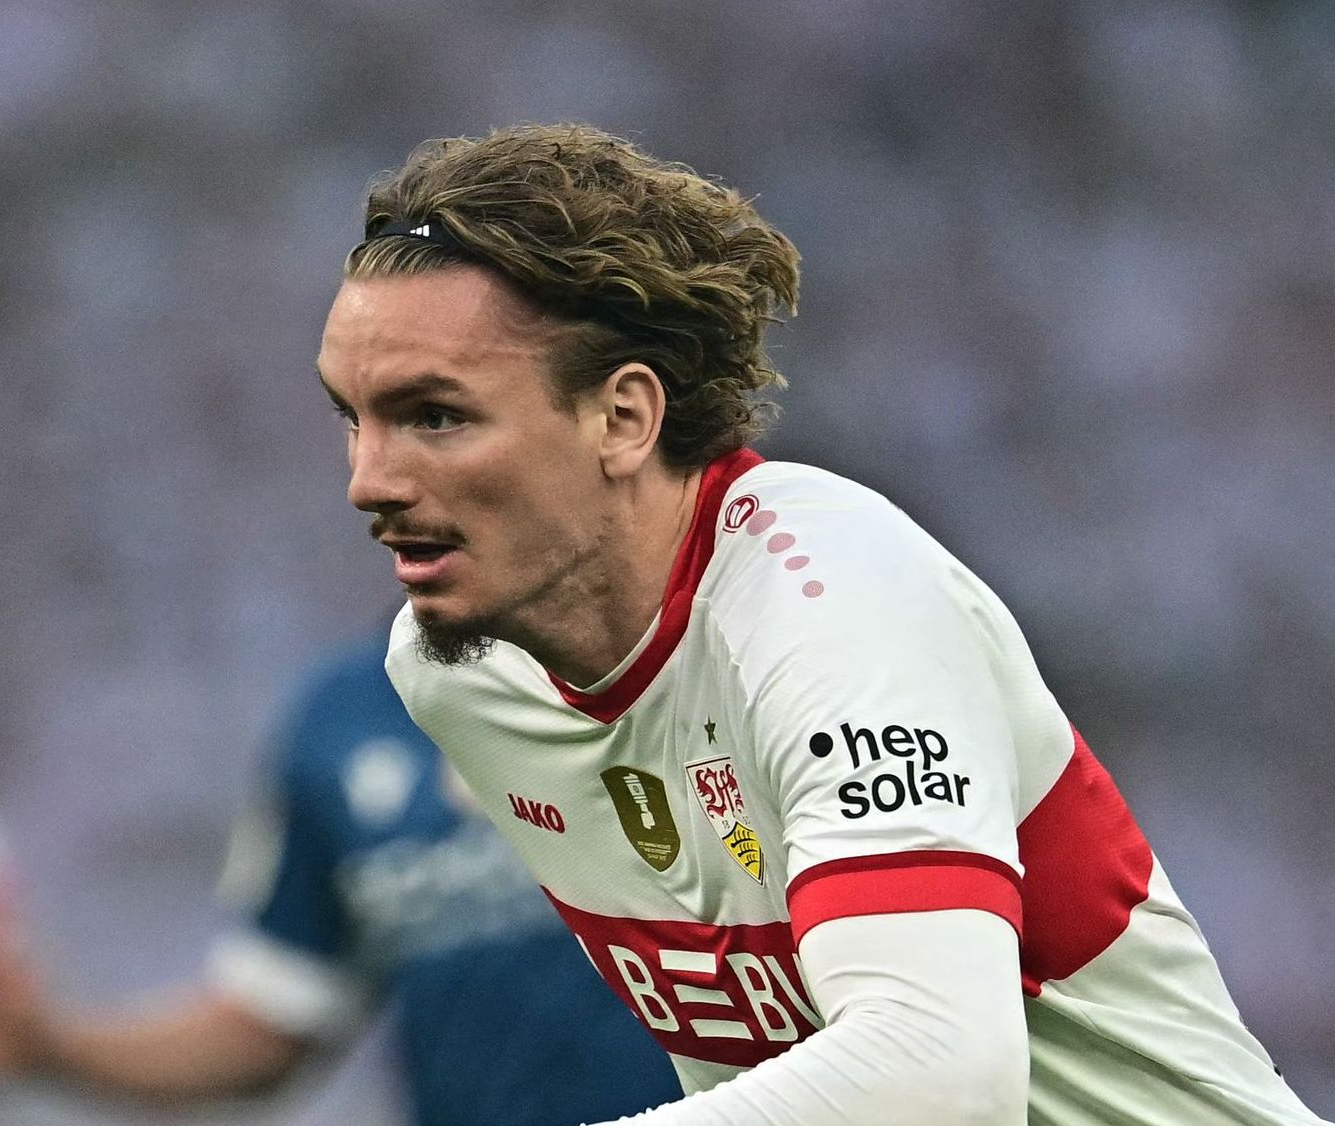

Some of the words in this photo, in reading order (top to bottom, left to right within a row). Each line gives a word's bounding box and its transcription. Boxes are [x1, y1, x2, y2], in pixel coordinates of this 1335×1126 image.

[840, 722, 949, 771] hep
[507, 792, 566, 834] JAKO
[838, 760, 971, 819] solar
